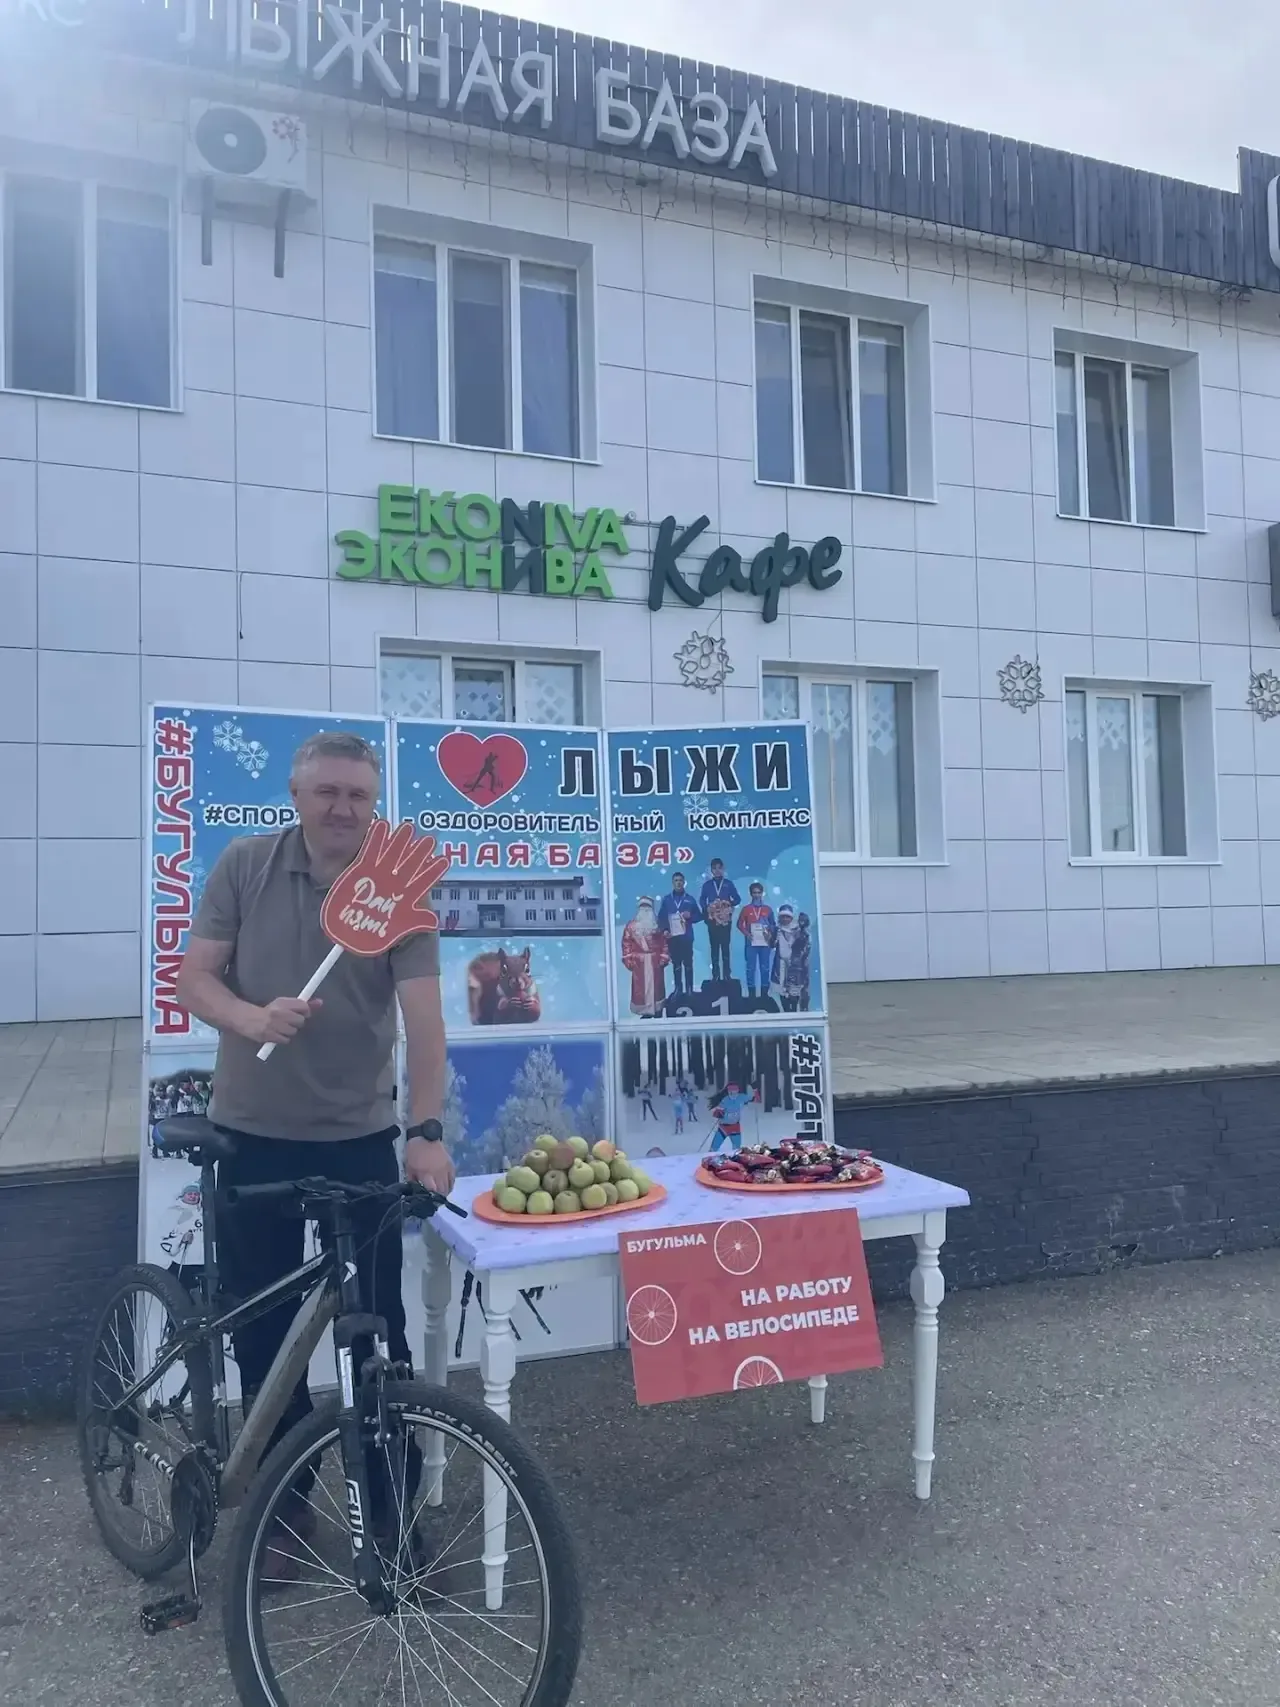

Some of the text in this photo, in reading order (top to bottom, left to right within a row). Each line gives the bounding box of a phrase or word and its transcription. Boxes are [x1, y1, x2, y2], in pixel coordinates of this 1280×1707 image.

[596, 67, 778, 178] БАЗА
[378, 484, 630, 555] EKONIVA
[335, 530, 614, 599] ЭКОНИВА
[648, 514, 843, 623] Кафе
[688, 808, 812, 832] КОМПЛЕКС
[351, 876, 404, 919] Дай
[791, 1033, 823, 1141] #ТАТ
[627, 1233, 707, 1253] БУГУЛЬМА
[741, 1276, 852, 1307] НА РАБОТУ
[688, 1304, 860, 1346] НА ВЕЛОСИПЕДЕ
